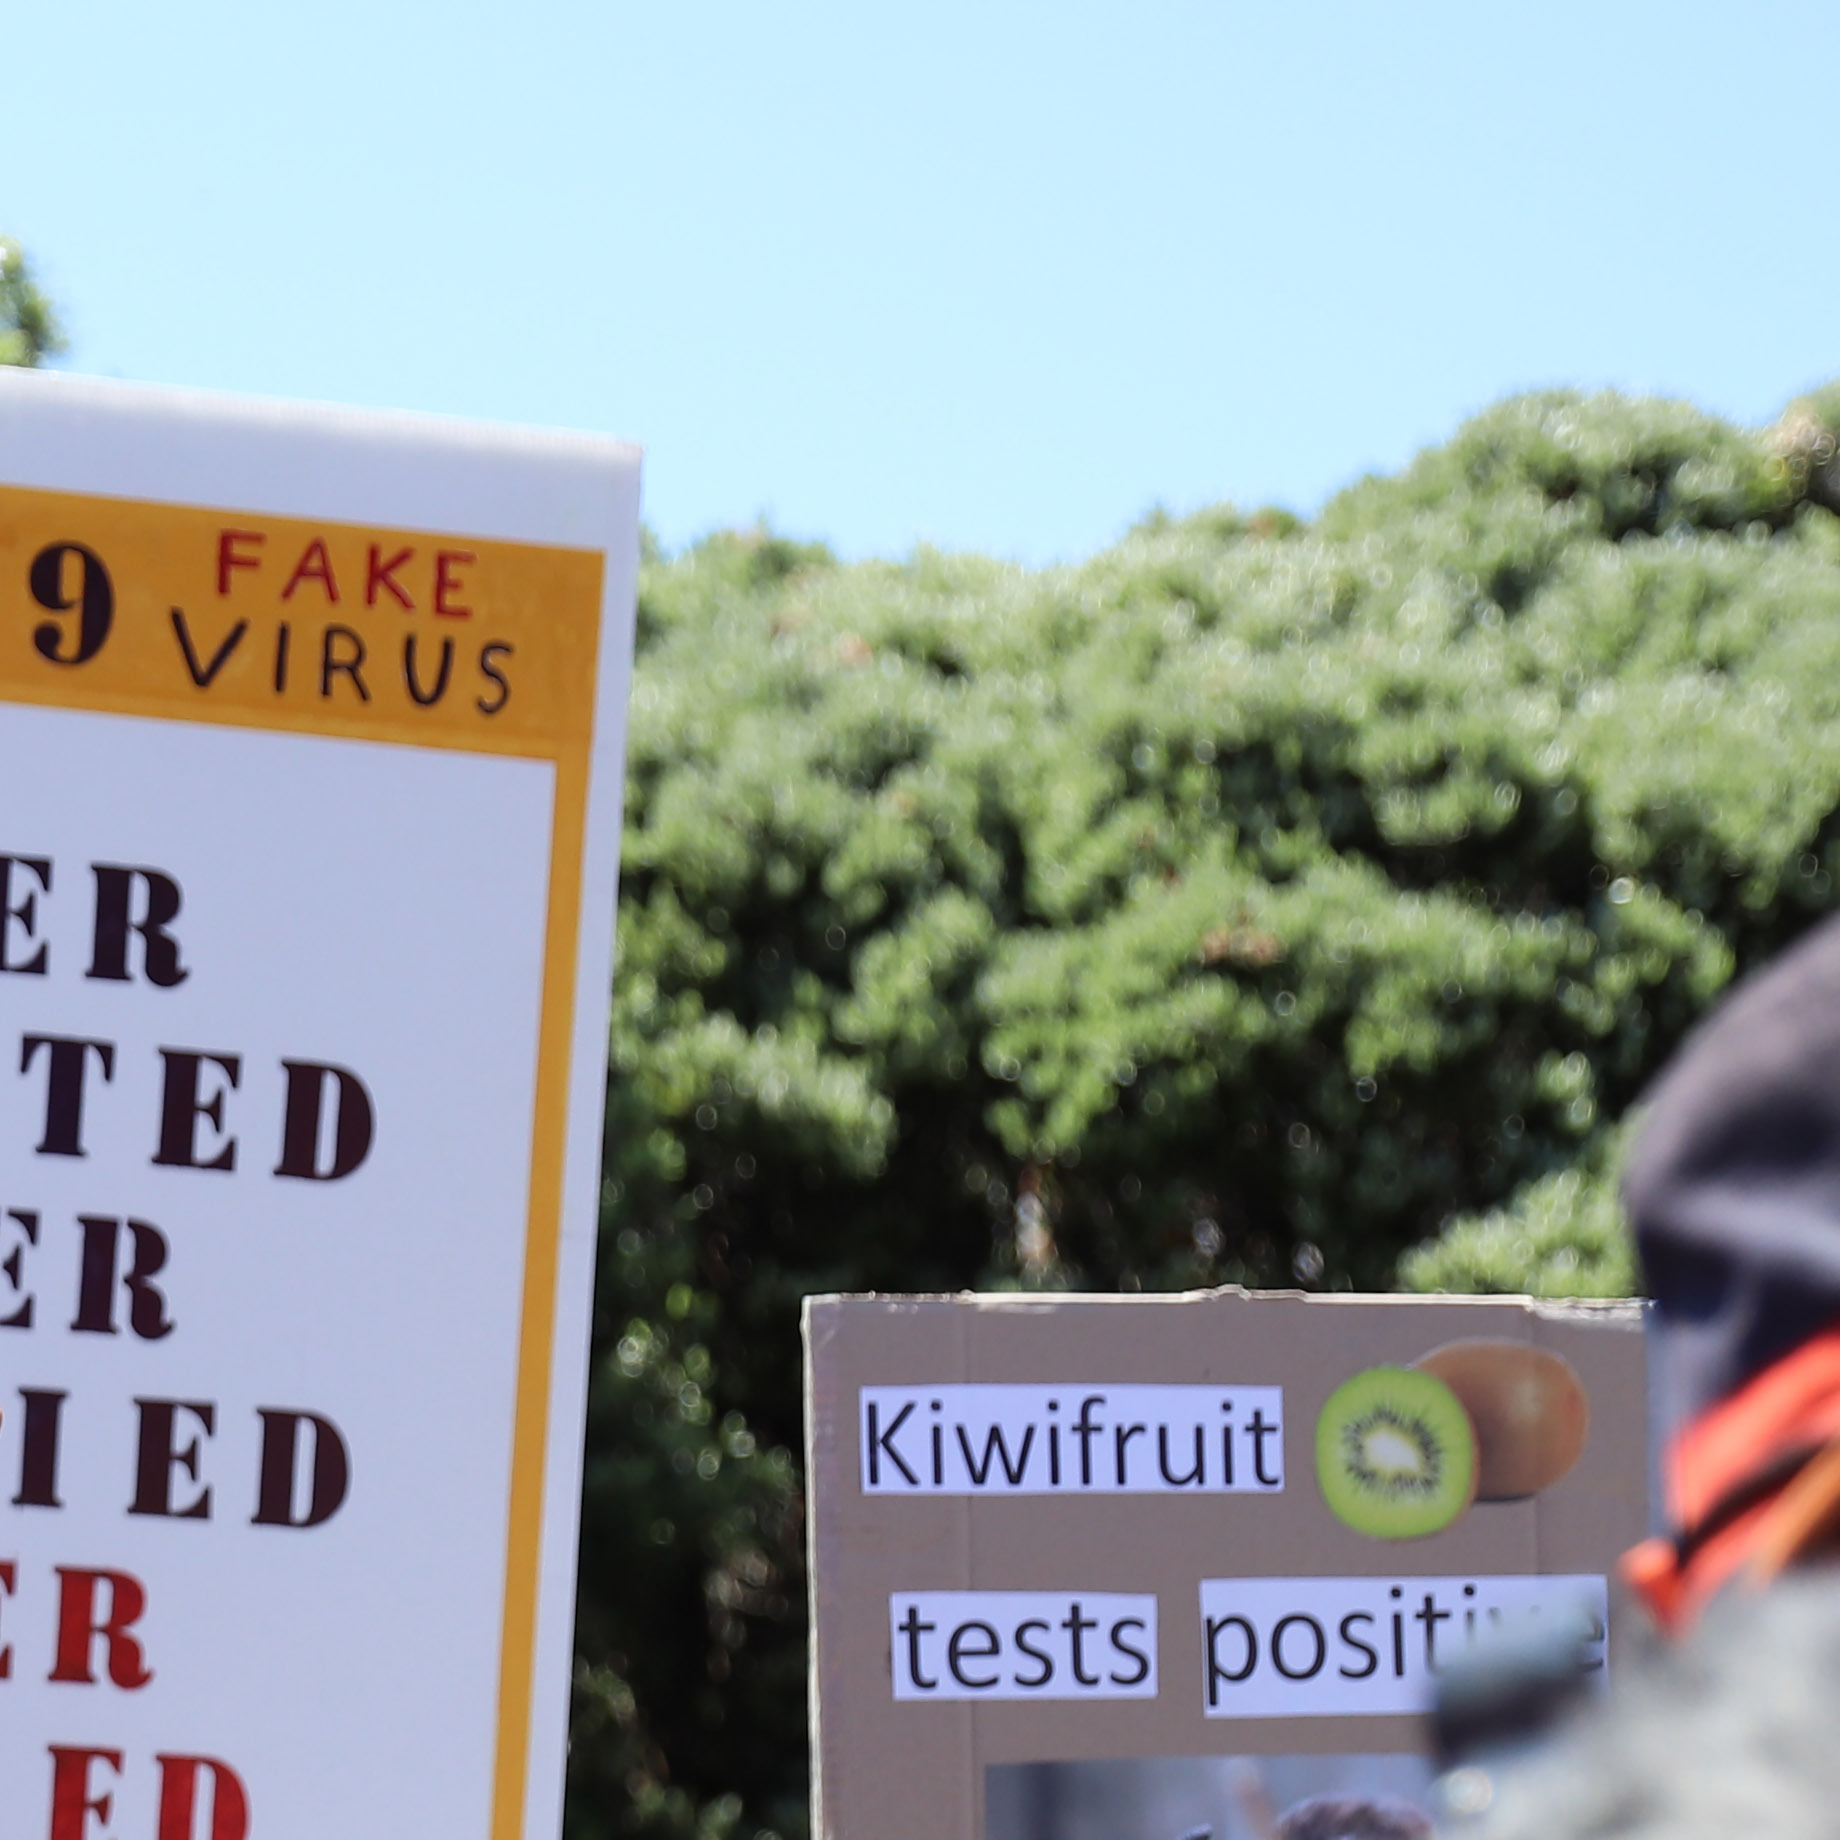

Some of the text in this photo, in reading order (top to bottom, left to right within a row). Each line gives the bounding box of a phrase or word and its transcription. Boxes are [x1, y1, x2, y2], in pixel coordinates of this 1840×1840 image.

[216, 529, 475, 620] FAKE
[168, 606, 515, 716] VIRUS
[867, 1396, 1280, 1487] Kiwifruit
[898, 1585, 1605, 1708] tests positi
